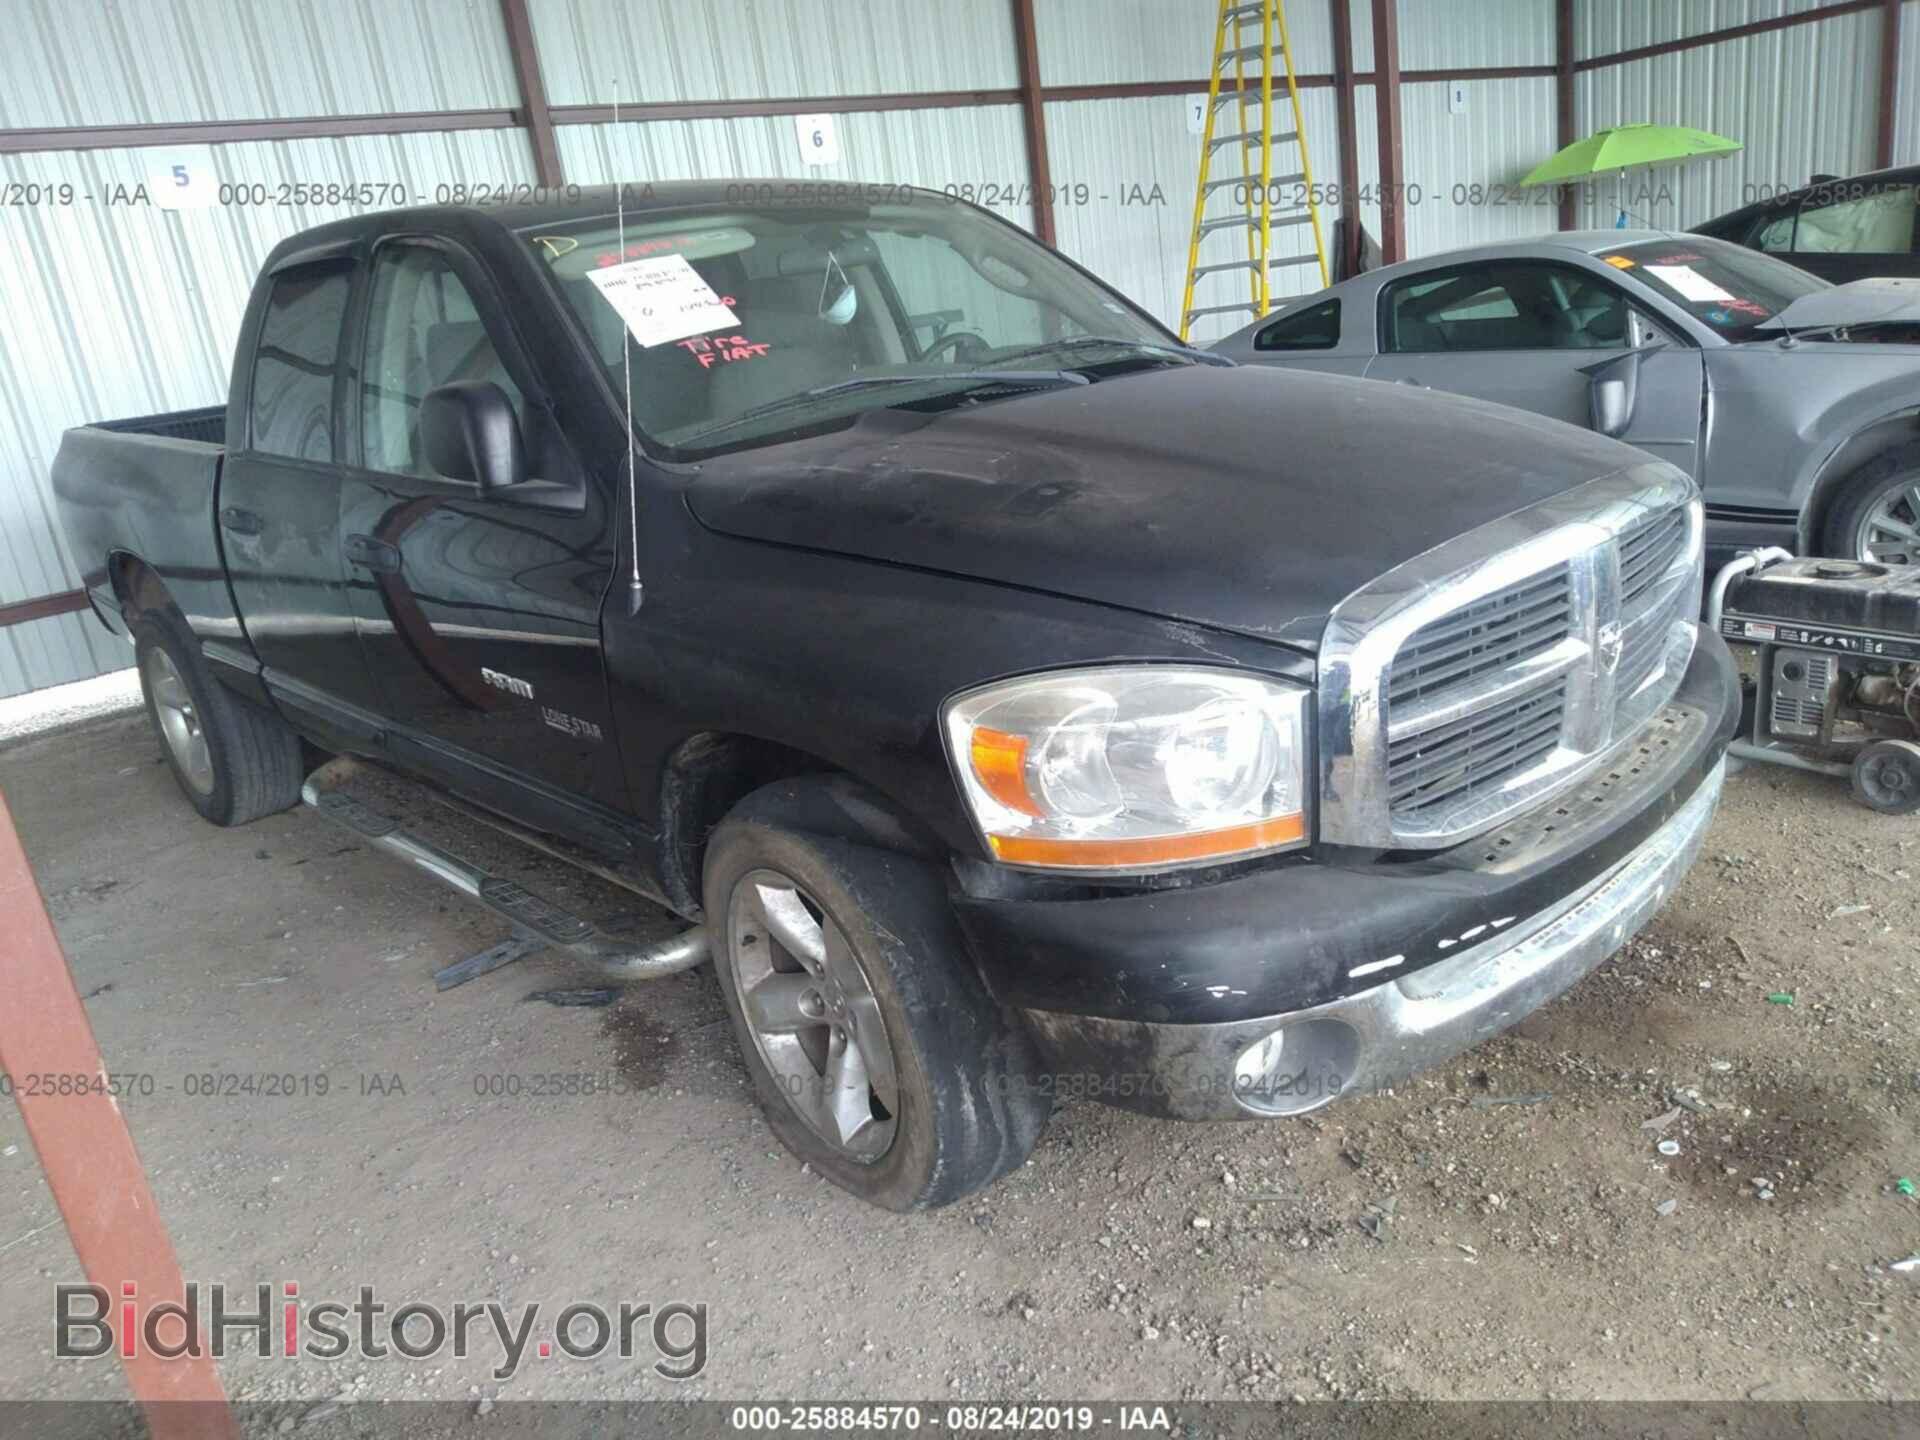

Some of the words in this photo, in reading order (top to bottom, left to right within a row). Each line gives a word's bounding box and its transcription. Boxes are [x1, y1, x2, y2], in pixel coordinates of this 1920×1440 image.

[1194, 105, 1202, 121] 7
[812, 130, 823, 148] 6
[173, 166, 189, 187] 5
